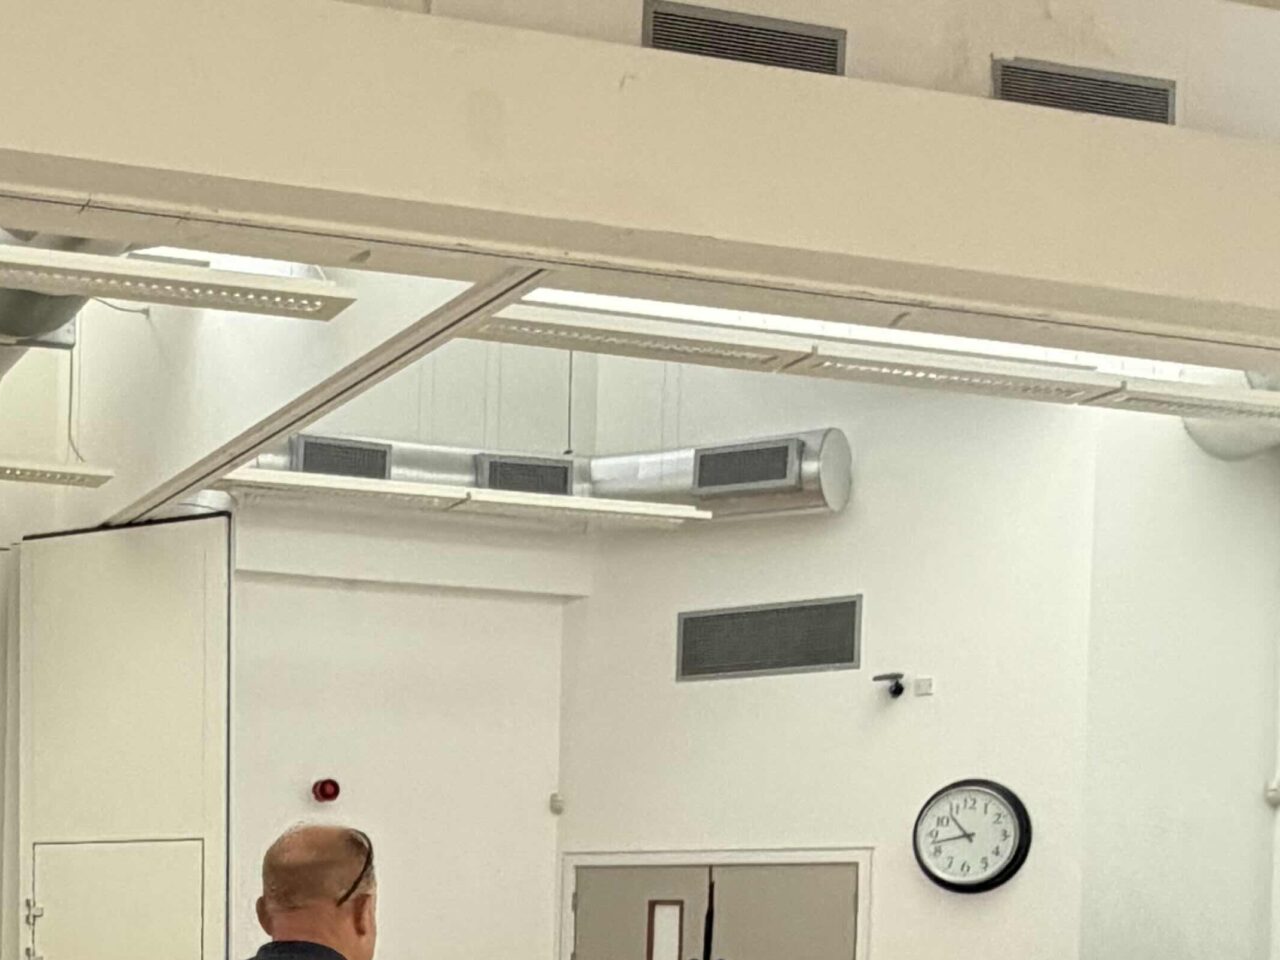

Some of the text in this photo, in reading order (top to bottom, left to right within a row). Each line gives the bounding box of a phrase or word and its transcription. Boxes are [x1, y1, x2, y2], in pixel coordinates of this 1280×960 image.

[963, 797, 977, 810] 12
[936, 815, 950, 828] 10
[993, 812, 1003, 825] 2
[928, 829, 939, 841] 9
[1000, 829, 1009, 842] 3
[933, 845, 942, 857] 8
[992, 845, 1001, 857] 4
[946, 856, 955, 869] 7
[960, 860, 971, 873] 6
[980, 857, 989, 871] 5
